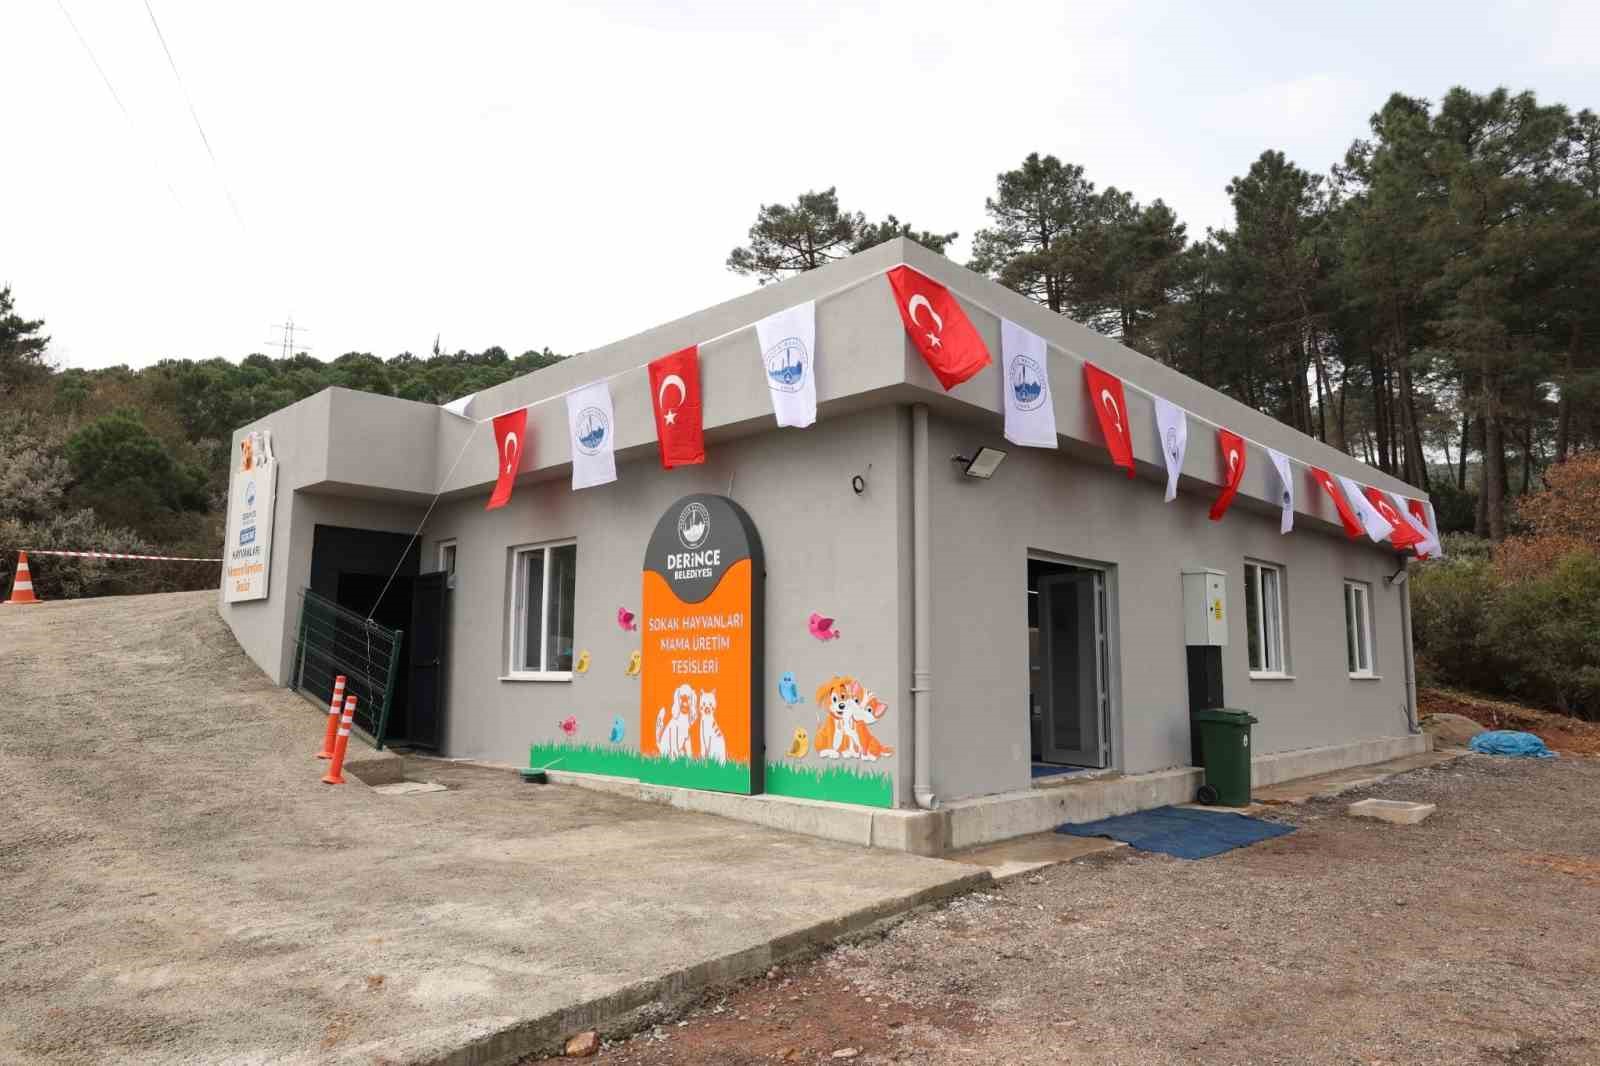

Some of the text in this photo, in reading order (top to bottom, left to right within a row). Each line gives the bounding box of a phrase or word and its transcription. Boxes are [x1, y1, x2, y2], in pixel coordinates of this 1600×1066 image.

[649, 613, 743, 632] SOKAK HAYVANLARI
[660, 635, 730, 650] MAMA ÜRETİM
[672, 658, 720, 673] TESİSLERİ
